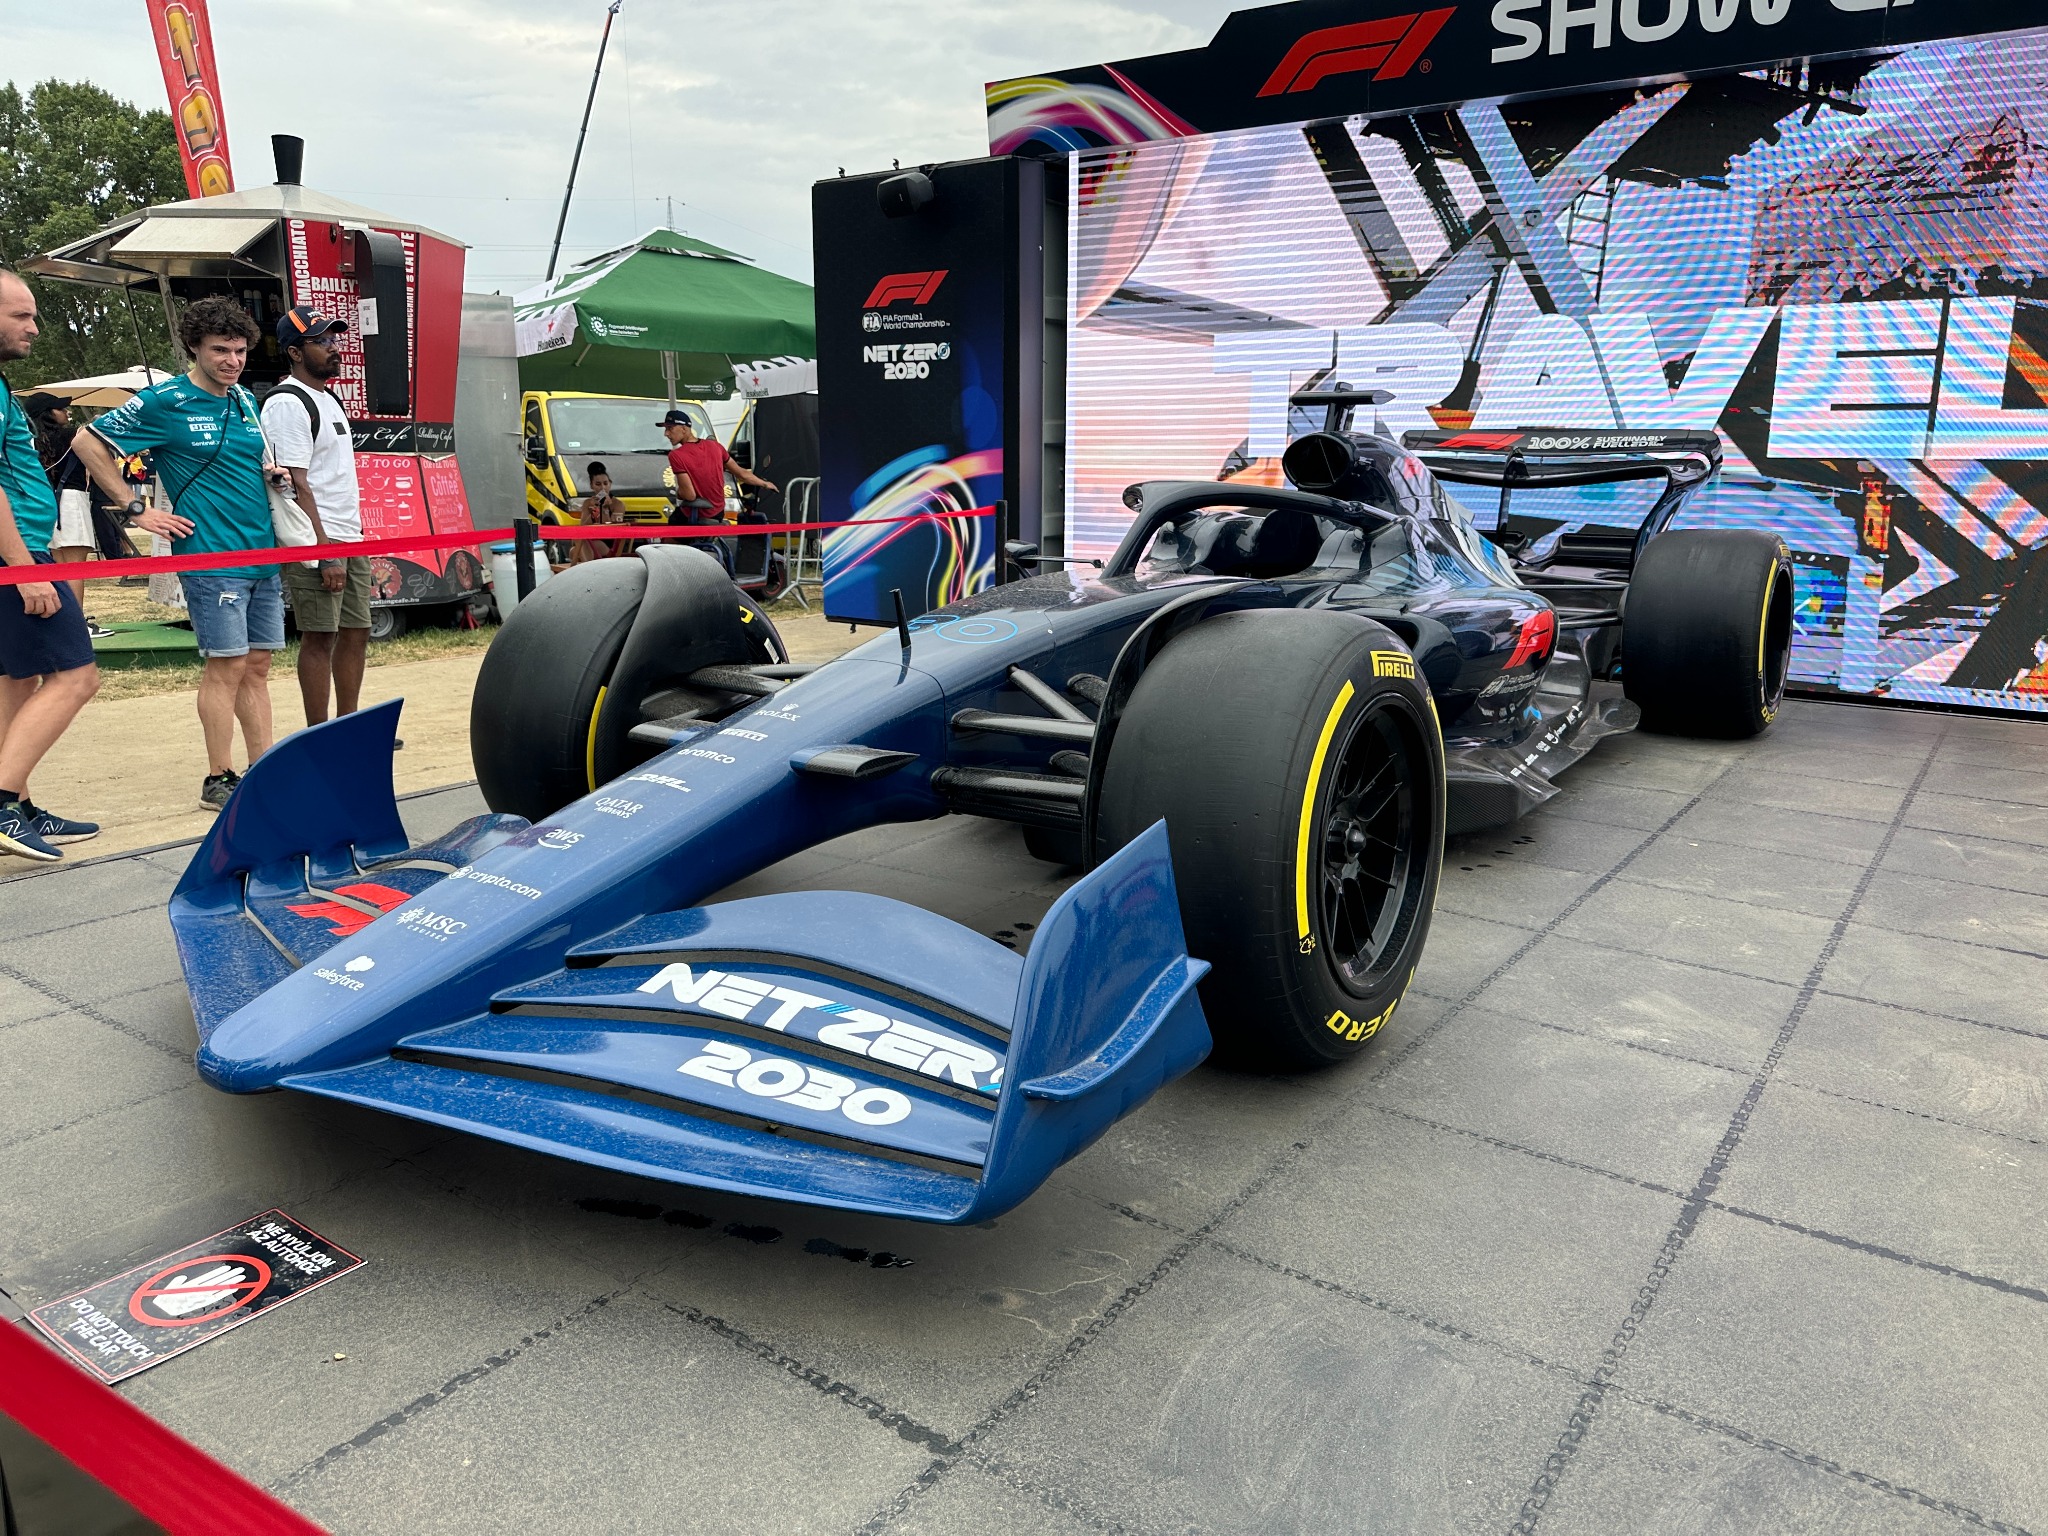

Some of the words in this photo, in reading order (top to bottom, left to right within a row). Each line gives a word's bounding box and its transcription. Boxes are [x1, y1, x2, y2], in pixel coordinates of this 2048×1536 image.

[290, 219, 313, 301] MACCHIATO
[883, 321, 901, 330] World
[901, 319, 946, 329] Championship
[893, 313, 919, 321] Formula
[341, 354, 362, 364] LATTE
[863, 344, 901, 363] NET
[902, 342, 951, 361] ZERO
[884, 361, 930, 380] 2030
[373, 425, 413, 449] Cafe
[439, 427, 454, 449] Cafe
[1527, 437, 1592, 449] 100%
[1593, 441, 1649, 449] FUELLED
[373, 458, 391, 468] TO
[392, 458, 411, 468] GO
[430, 475, 460, 497] Coffee
[1370, 650, 1416, 680] PIRELLI
[754, 709, 801, 722] ROLEX
[677, 748, 736, 764] aramco
[594, 806, 633, 819] AIRWAYS
[595, 797, 644, 814] QATAR
[545, 828, 585, 844] aws
[468, 869, 543, 900] crypto.com
[406, 923, 448, 943] CRUISES
[415, 911, 468, 936] MSC
[313, 966, 365, 992] salesforce
[636, 962, 837, 1032] NET
[676, 1039, 912, 1126] 2030
[245, 1230, 271, 1243] AZ
[261, 1222, 286, 1237] NE
[68, 1317, 100, 1340] THE
[88, 1335, 121, 1357] CAR
[69, 1298, 95, 1316] DO
[84, 1311, 119, 1333] NOT
[110, 1327, 156, 1361] TOUCH
